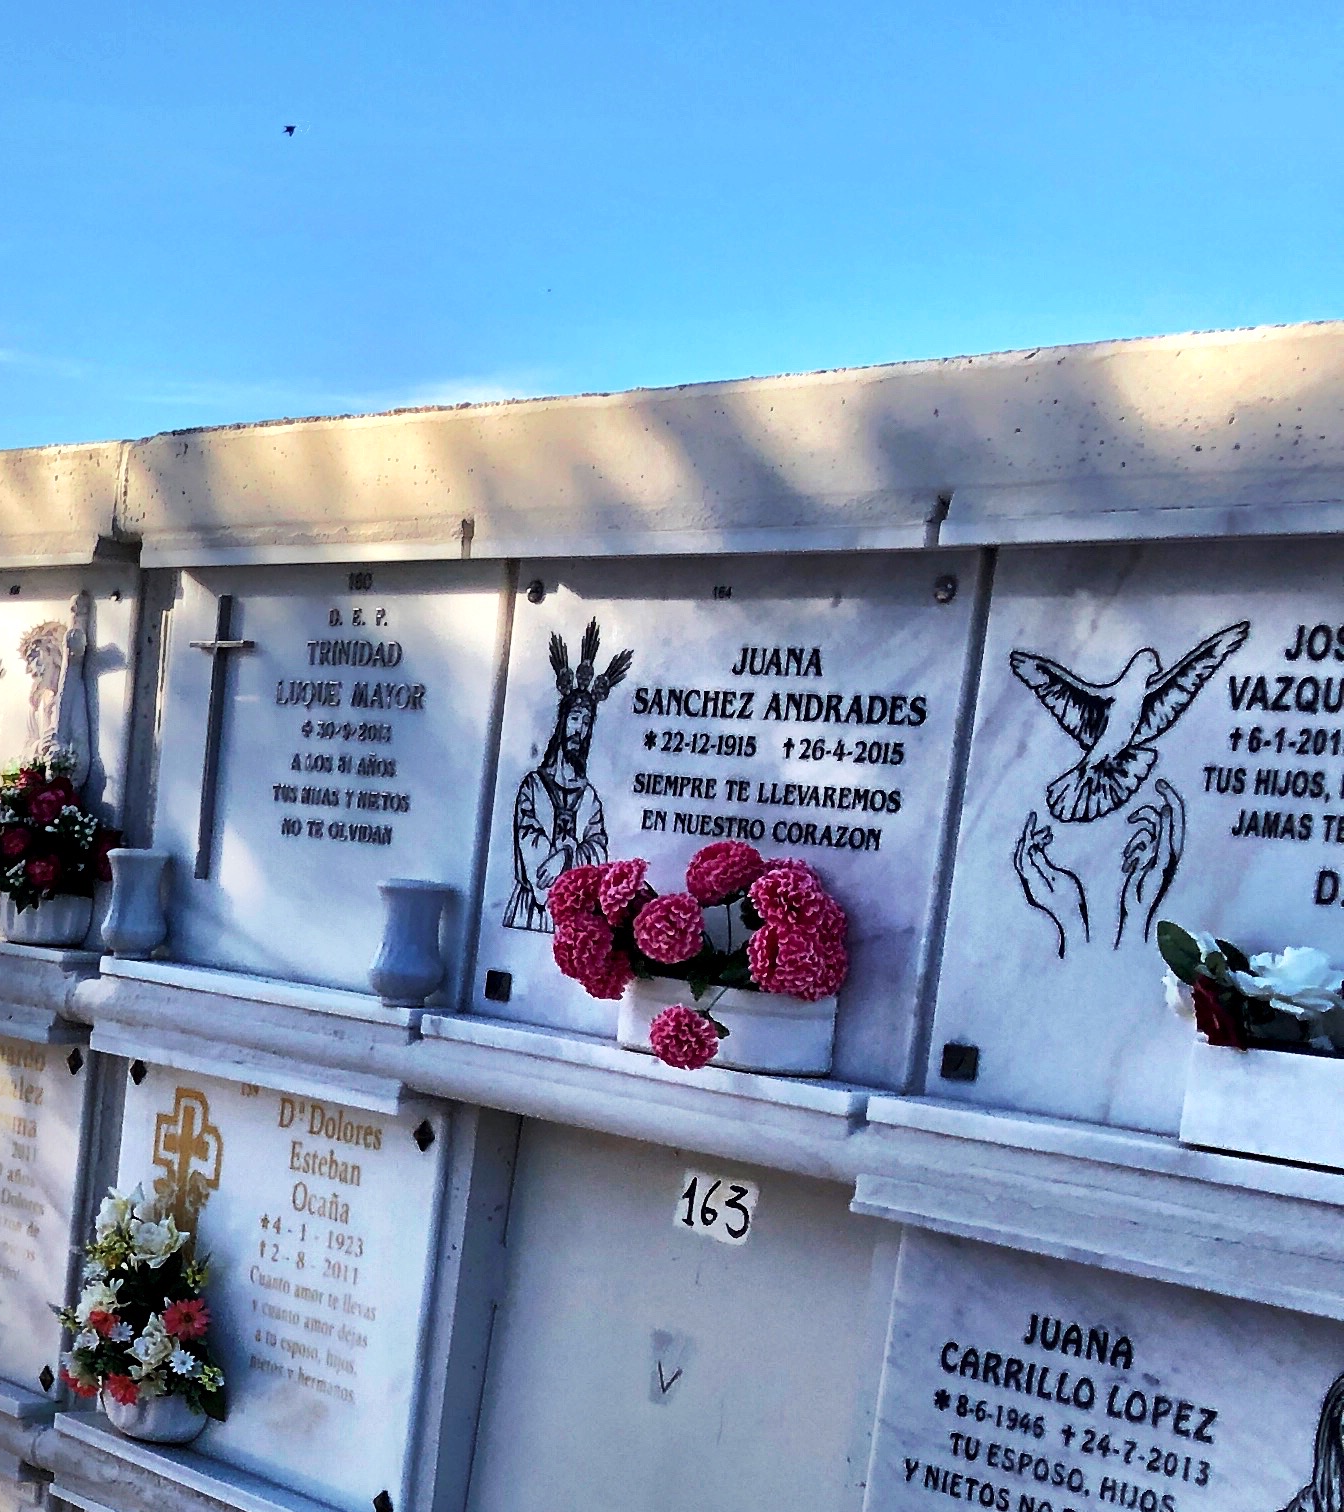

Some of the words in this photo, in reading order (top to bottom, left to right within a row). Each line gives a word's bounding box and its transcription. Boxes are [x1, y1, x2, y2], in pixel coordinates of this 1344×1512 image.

[713, 586, 733, 599] 164
[329, 608, 343, 626] D.
[352, 608, 366, 626] E.
[375, 607, 388, 626] P.
[307, 640, 403, 668] TRINIDAD
[731, 647, 823, 677] JUANA
[276, 680, 343, 709] LUQUE
[351, 681, 426, 709] MAYOR
[633, 688, 755, 720] SANCHEZ
[763, 692, 928, 727] ANDRADES
[291, 753, 301, 771] A
[305, 754, 334, 774] LOS
[357, 752, 397, 777] AÑOS
[272, 783, 298, 804] TUS
[345, 789, 354, 809] Y
[357, 790, 410, 813] NIETOS
[633, 773, 717, 799] SIEMPRE
[726, 779, 751, 802] TE
[758, 782, 902, 813] LLEVAREMOS
[1203, 766, 1247, 795] TUS
[1253, 768, 1330, 804] HIJOS,
[281, 818, 302, 837] NO
[307, 819, 324, 838] TE
[328, 822, 393, 845] OLVIDAN
[641, 809, 667, 831] EN
[673, 813, 766, 839] NUESTRO
[772, 822, 882, 851] CORAZON
[1231, 808, 1313, 841] JAMAS
[308, 1103, 383, 1151] Dolores
[289, 1140, 361, 1187] Esteban
[292, 1181, 350, 1225] Ocaña
[681, 1176, 751, 1239] 163
[249, 1264, 291, 1295] Cuanto
[294, 1283, 325, 1306] amor
[342, 1294, 378, 1322] llevas
[262, 1302, 300, 1326] cuanto
[304, 1315, 336, 1337] amor
[1023, 1313, 1135, 1370] JUANA
[940, 1341, 1096, 1411] CARRILLO
[1106, 1384, 1219, 1445] LOPEZ
[950, 1431, 980, 1463] TU
[986, 1443, 1091, 1497] ESPOSO,
[904, 1457, 922, 1484] Y
[923, 1465, 1011, 1512] NIETOS
